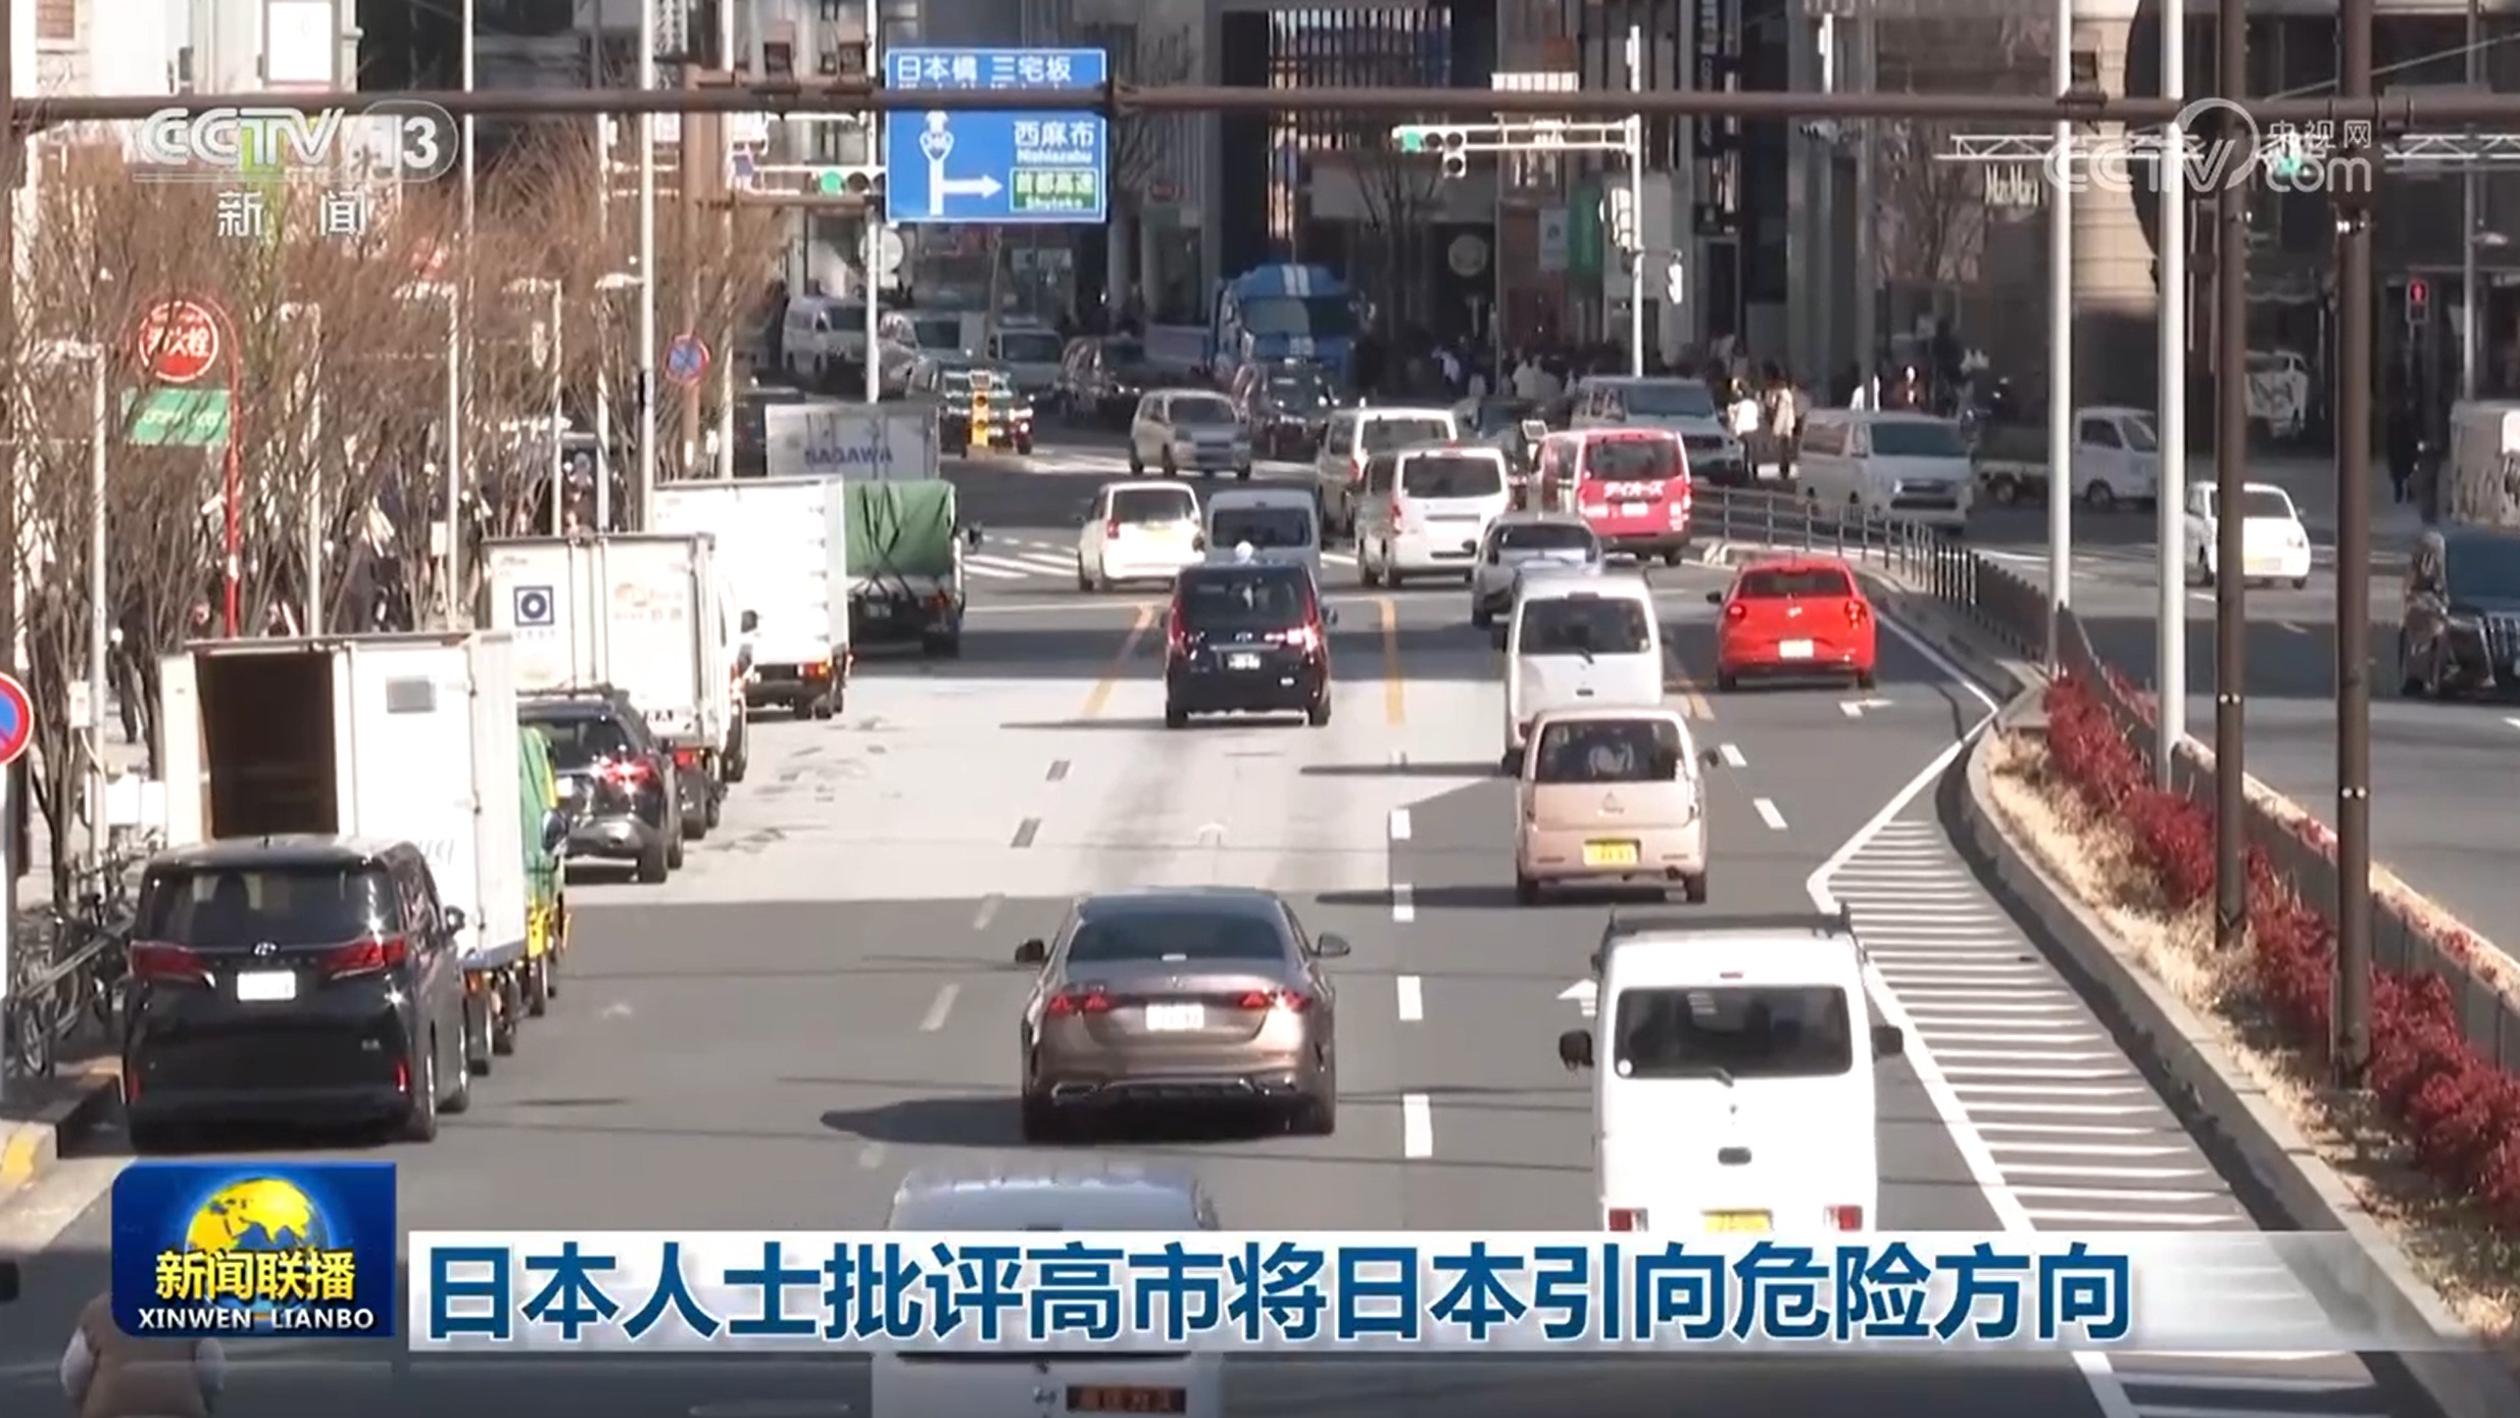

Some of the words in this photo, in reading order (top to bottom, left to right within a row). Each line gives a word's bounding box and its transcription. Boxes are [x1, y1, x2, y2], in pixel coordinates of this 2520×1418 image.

[898, 55, 977, 82] 日本橋
[991, 55, 1072, 82] 三宅坂
[1014, 121, 1095, 148] 西麻布
